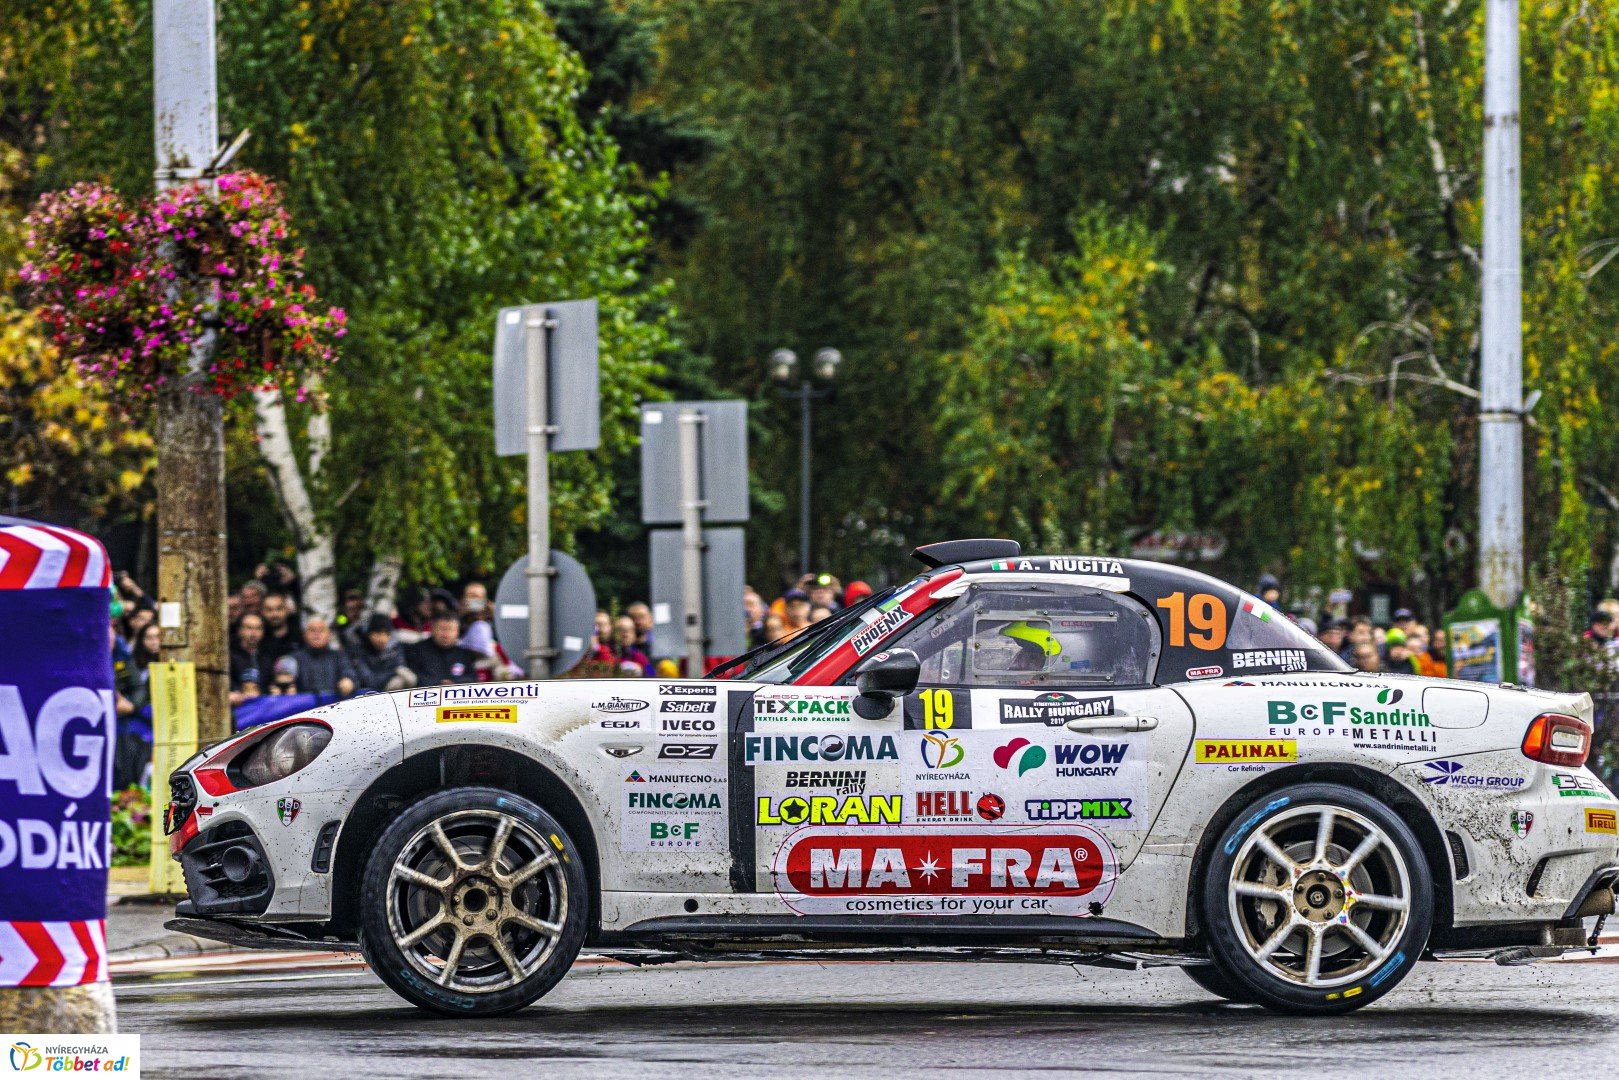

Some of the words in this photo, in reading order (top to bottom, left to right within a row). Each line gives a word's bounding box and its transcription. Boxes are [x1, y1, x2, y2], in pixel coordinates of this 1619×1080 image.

[1019, 560, 1041, 571] A.
[1049, 560, 1124, 574] NUCITA
[1156, 591, 1227, 651] 19
[853, 605, 909, 652] PHOENIX
[1232, 650, 1306, 668] BERNINI
[1281, 660, 1308, 671] rally
[444, 684, 539, 698] miwenti
[674, 686, 715, 694] Experis
[665, 701, 710, 712] Sabelt
[754, 699, 850, 714] TEXPACK
[918, 687, 954, 730] 19
[1003, 703, 1045, 719] RALLY
[1047, 699, 1111, 717] HUNGARY
[442, 708, 511, 720] PIRELLI
[662, 720, 716, 731] IVECO
[1269, 728, 1350, 736] EUROPE
[1352, 728, 1437, 743] METALLI
[745, 734, 899, 762] FINCOMA
[1204, 744, 1290, 758] PALINAL
[1353, 742, 1437, 752] www.sandrinimetalli.it
[1054, 744, 1130, 765] WOW
[1056, 767, 1119, 778] HUNGARY
[1241, 764, 1266, 772] Refinish
[648, 774, 712, 783] MANUTECNO
[785, 770, 867, 787] BERNINI
[915, 772, 971, 780] NYÍREGYHÁZA
[1450, 775, 1484, 785] WEGH
[1486, 776, 1525, 787] GROUP
[836, 783, 866, 796] rally
[628, 793, 722, 809] FINCOMA
[916, 791, 973, 817] HELL
[756, 795, 904, 826] LORAN
[845, 897, 934, 912] cosmetics
[940, 896, 966, 911] for
[972, 897, 1015, 914] your
[1021, 898, 1049, 910] car
